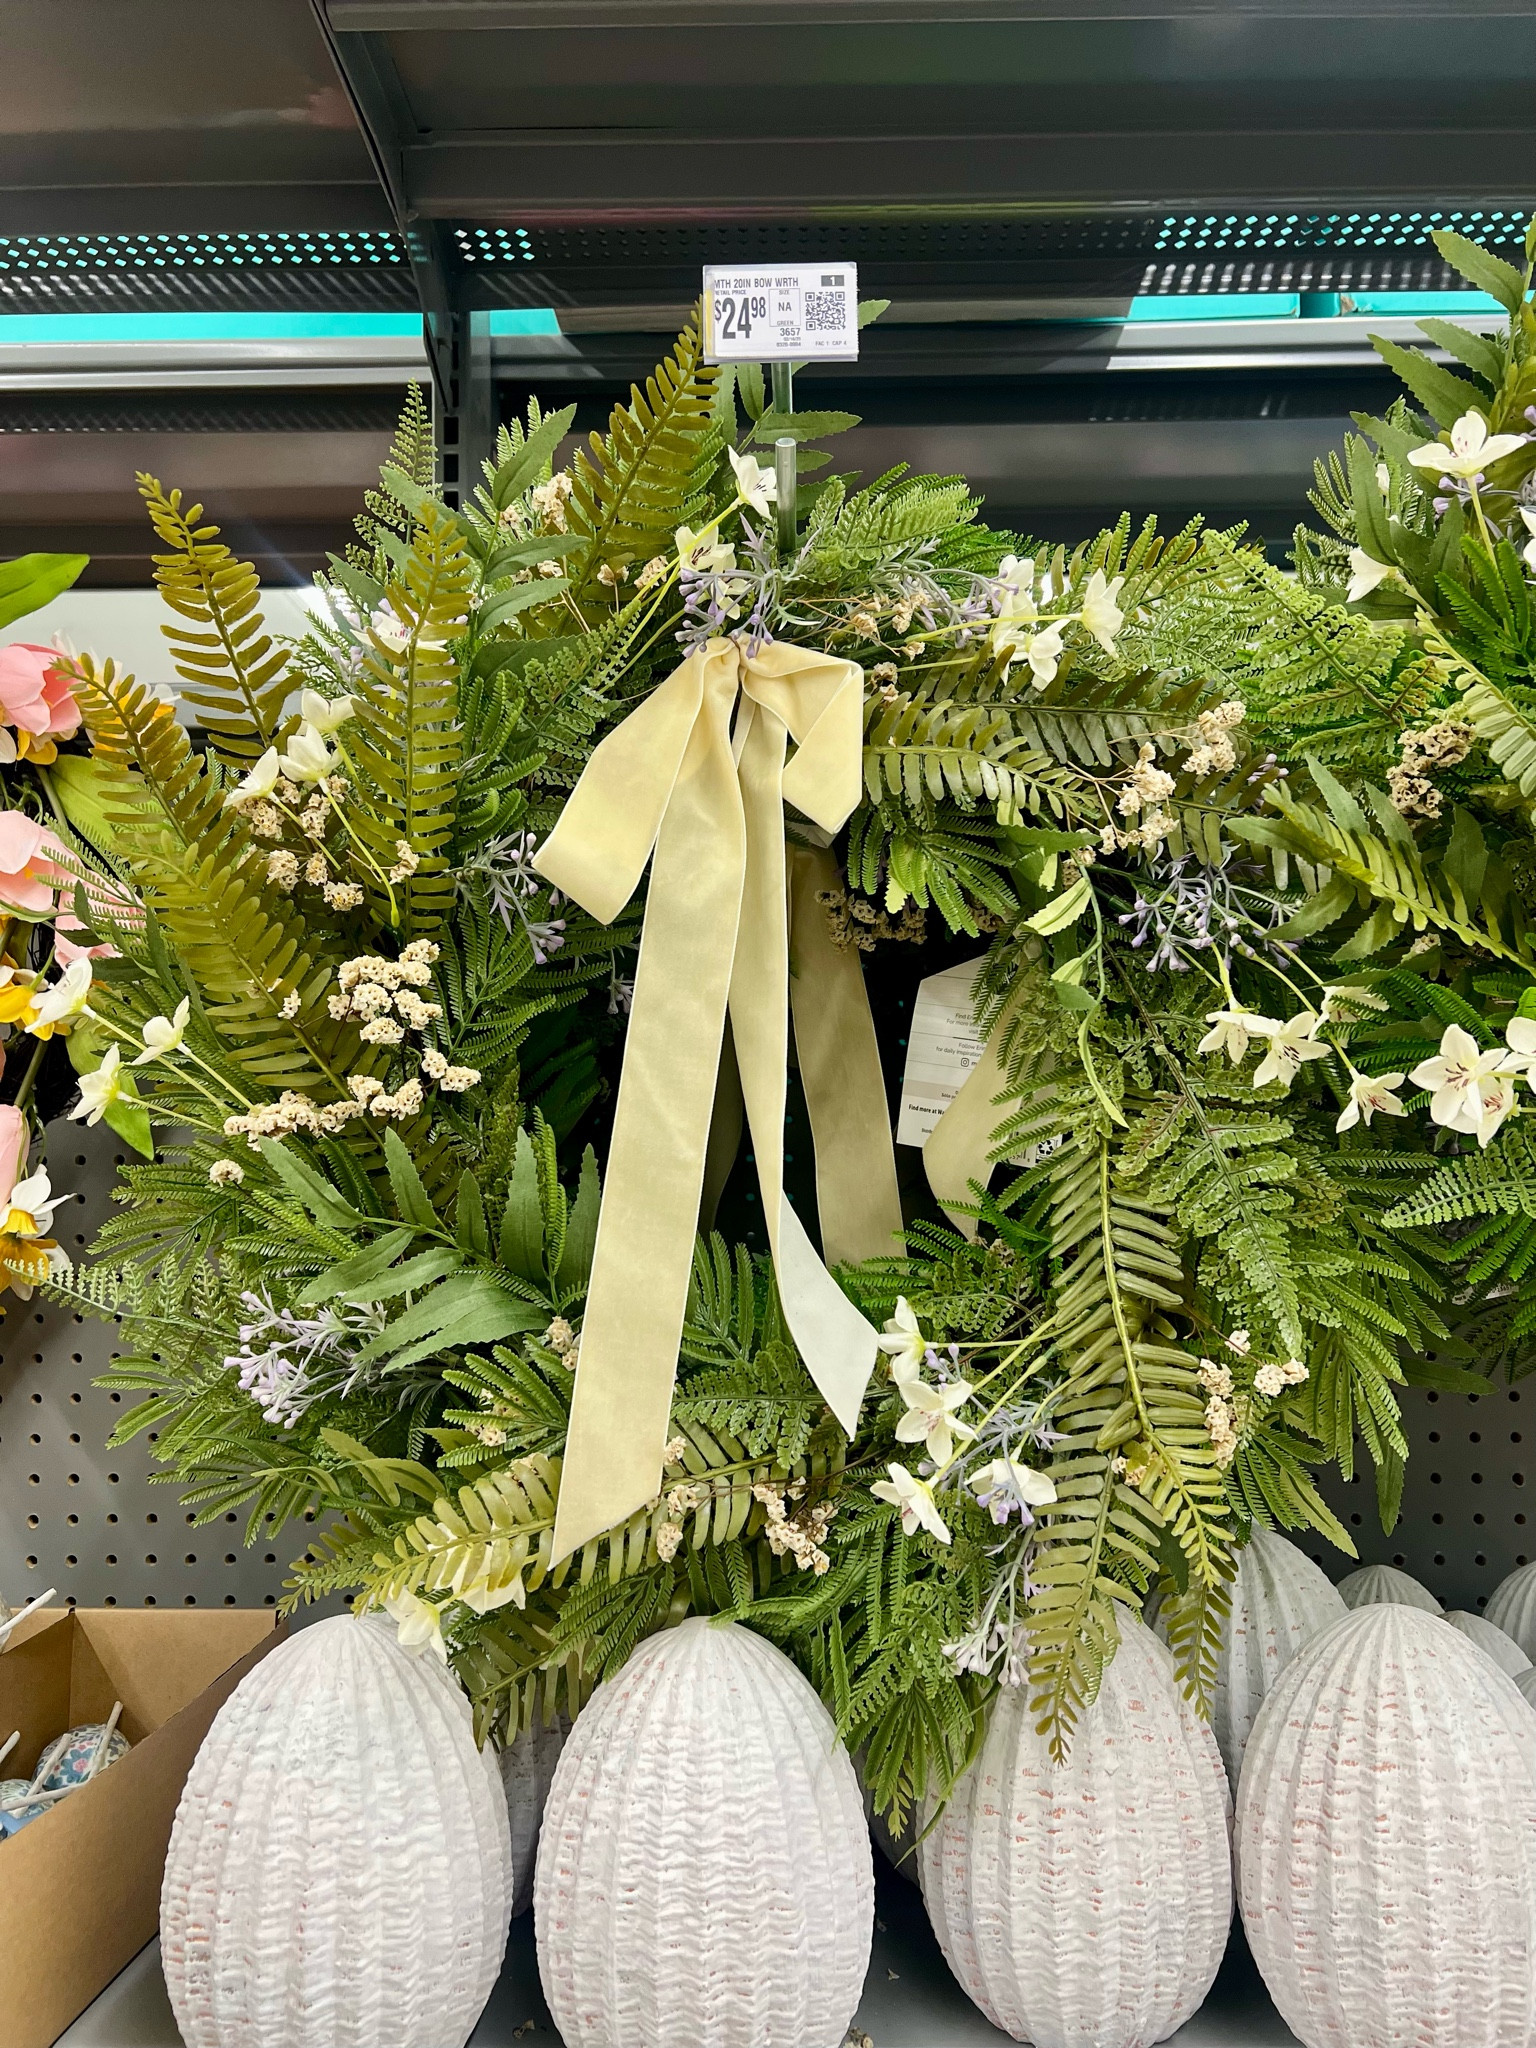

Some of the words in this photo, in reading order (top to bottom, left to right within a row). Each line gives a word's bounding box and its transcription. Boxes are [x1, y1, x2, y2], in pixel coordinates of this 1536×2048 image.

[733, 279, 751, 288] 20IN
[754, 278, 772, 288] BOW
[775, 277, 799, 287] WRTH
[829, 276, 836, 286] 1
[778, 302, 792, 311] NA
[780, 327, 801, 336] 3657
[908, 1103, 919, 1111] Find
[919, 1106, 931, 1114] more
